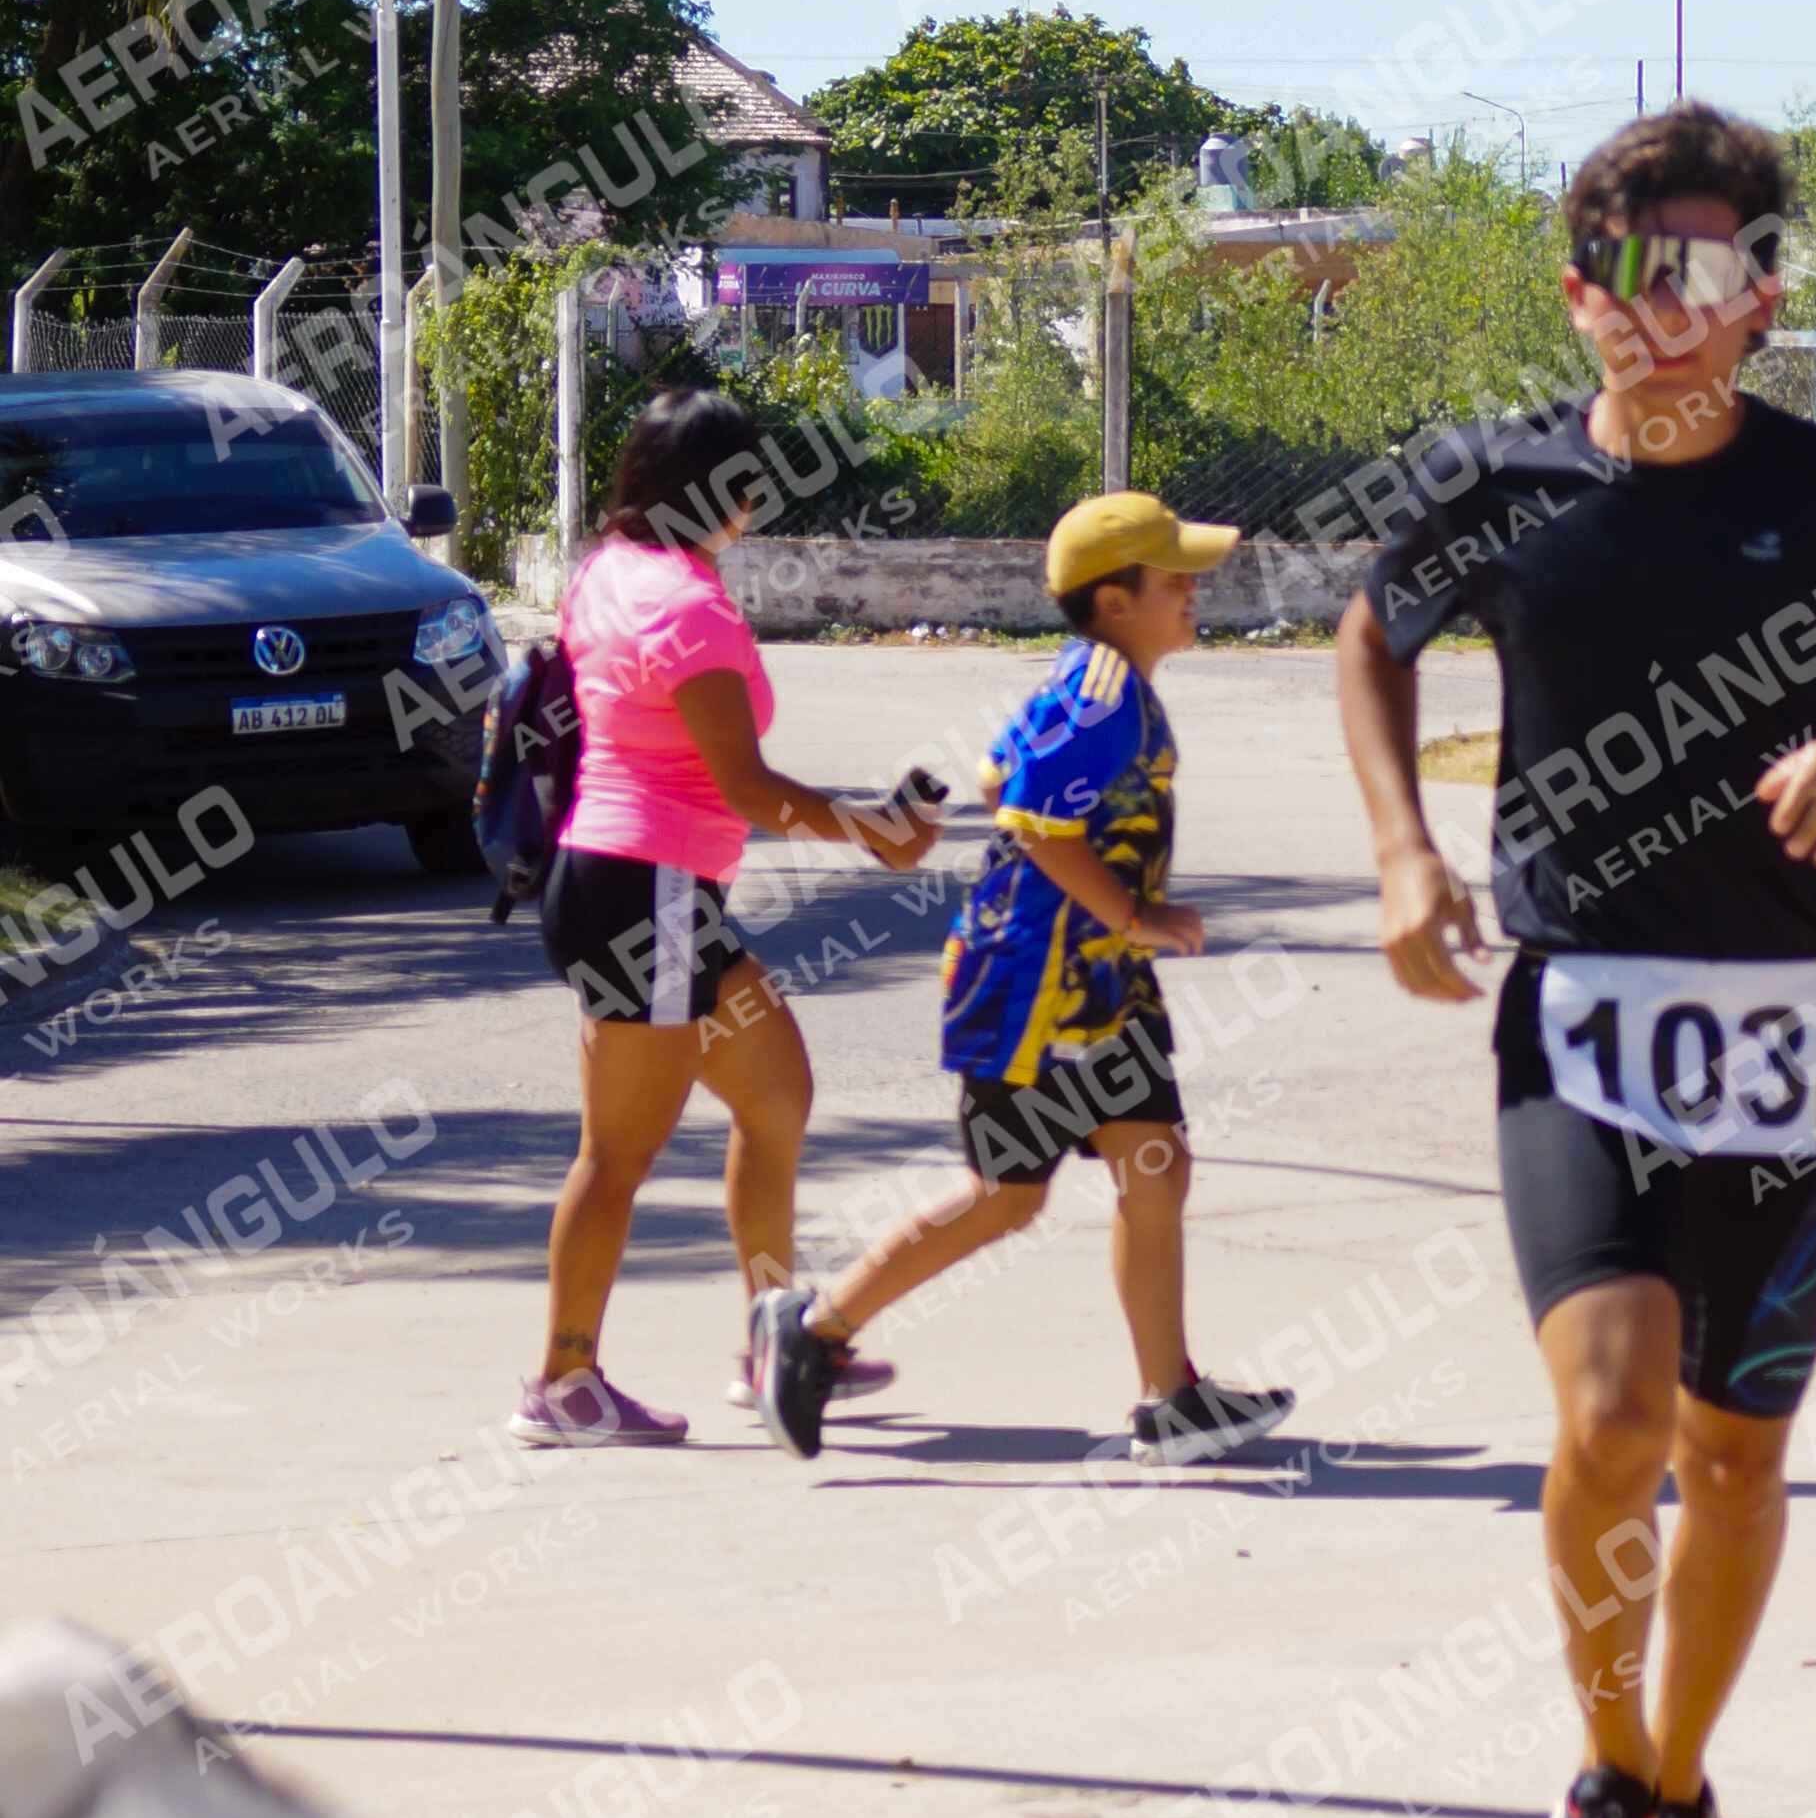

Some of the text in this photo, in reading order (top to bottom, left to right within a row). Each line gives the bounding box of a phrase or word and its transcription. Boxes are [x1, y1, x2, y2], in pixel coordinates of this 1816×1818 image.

[819, 282, 882, 297] CURVA
[238, 709, 263, 731] AB
[1566, 997, 1809, 1128] 103
